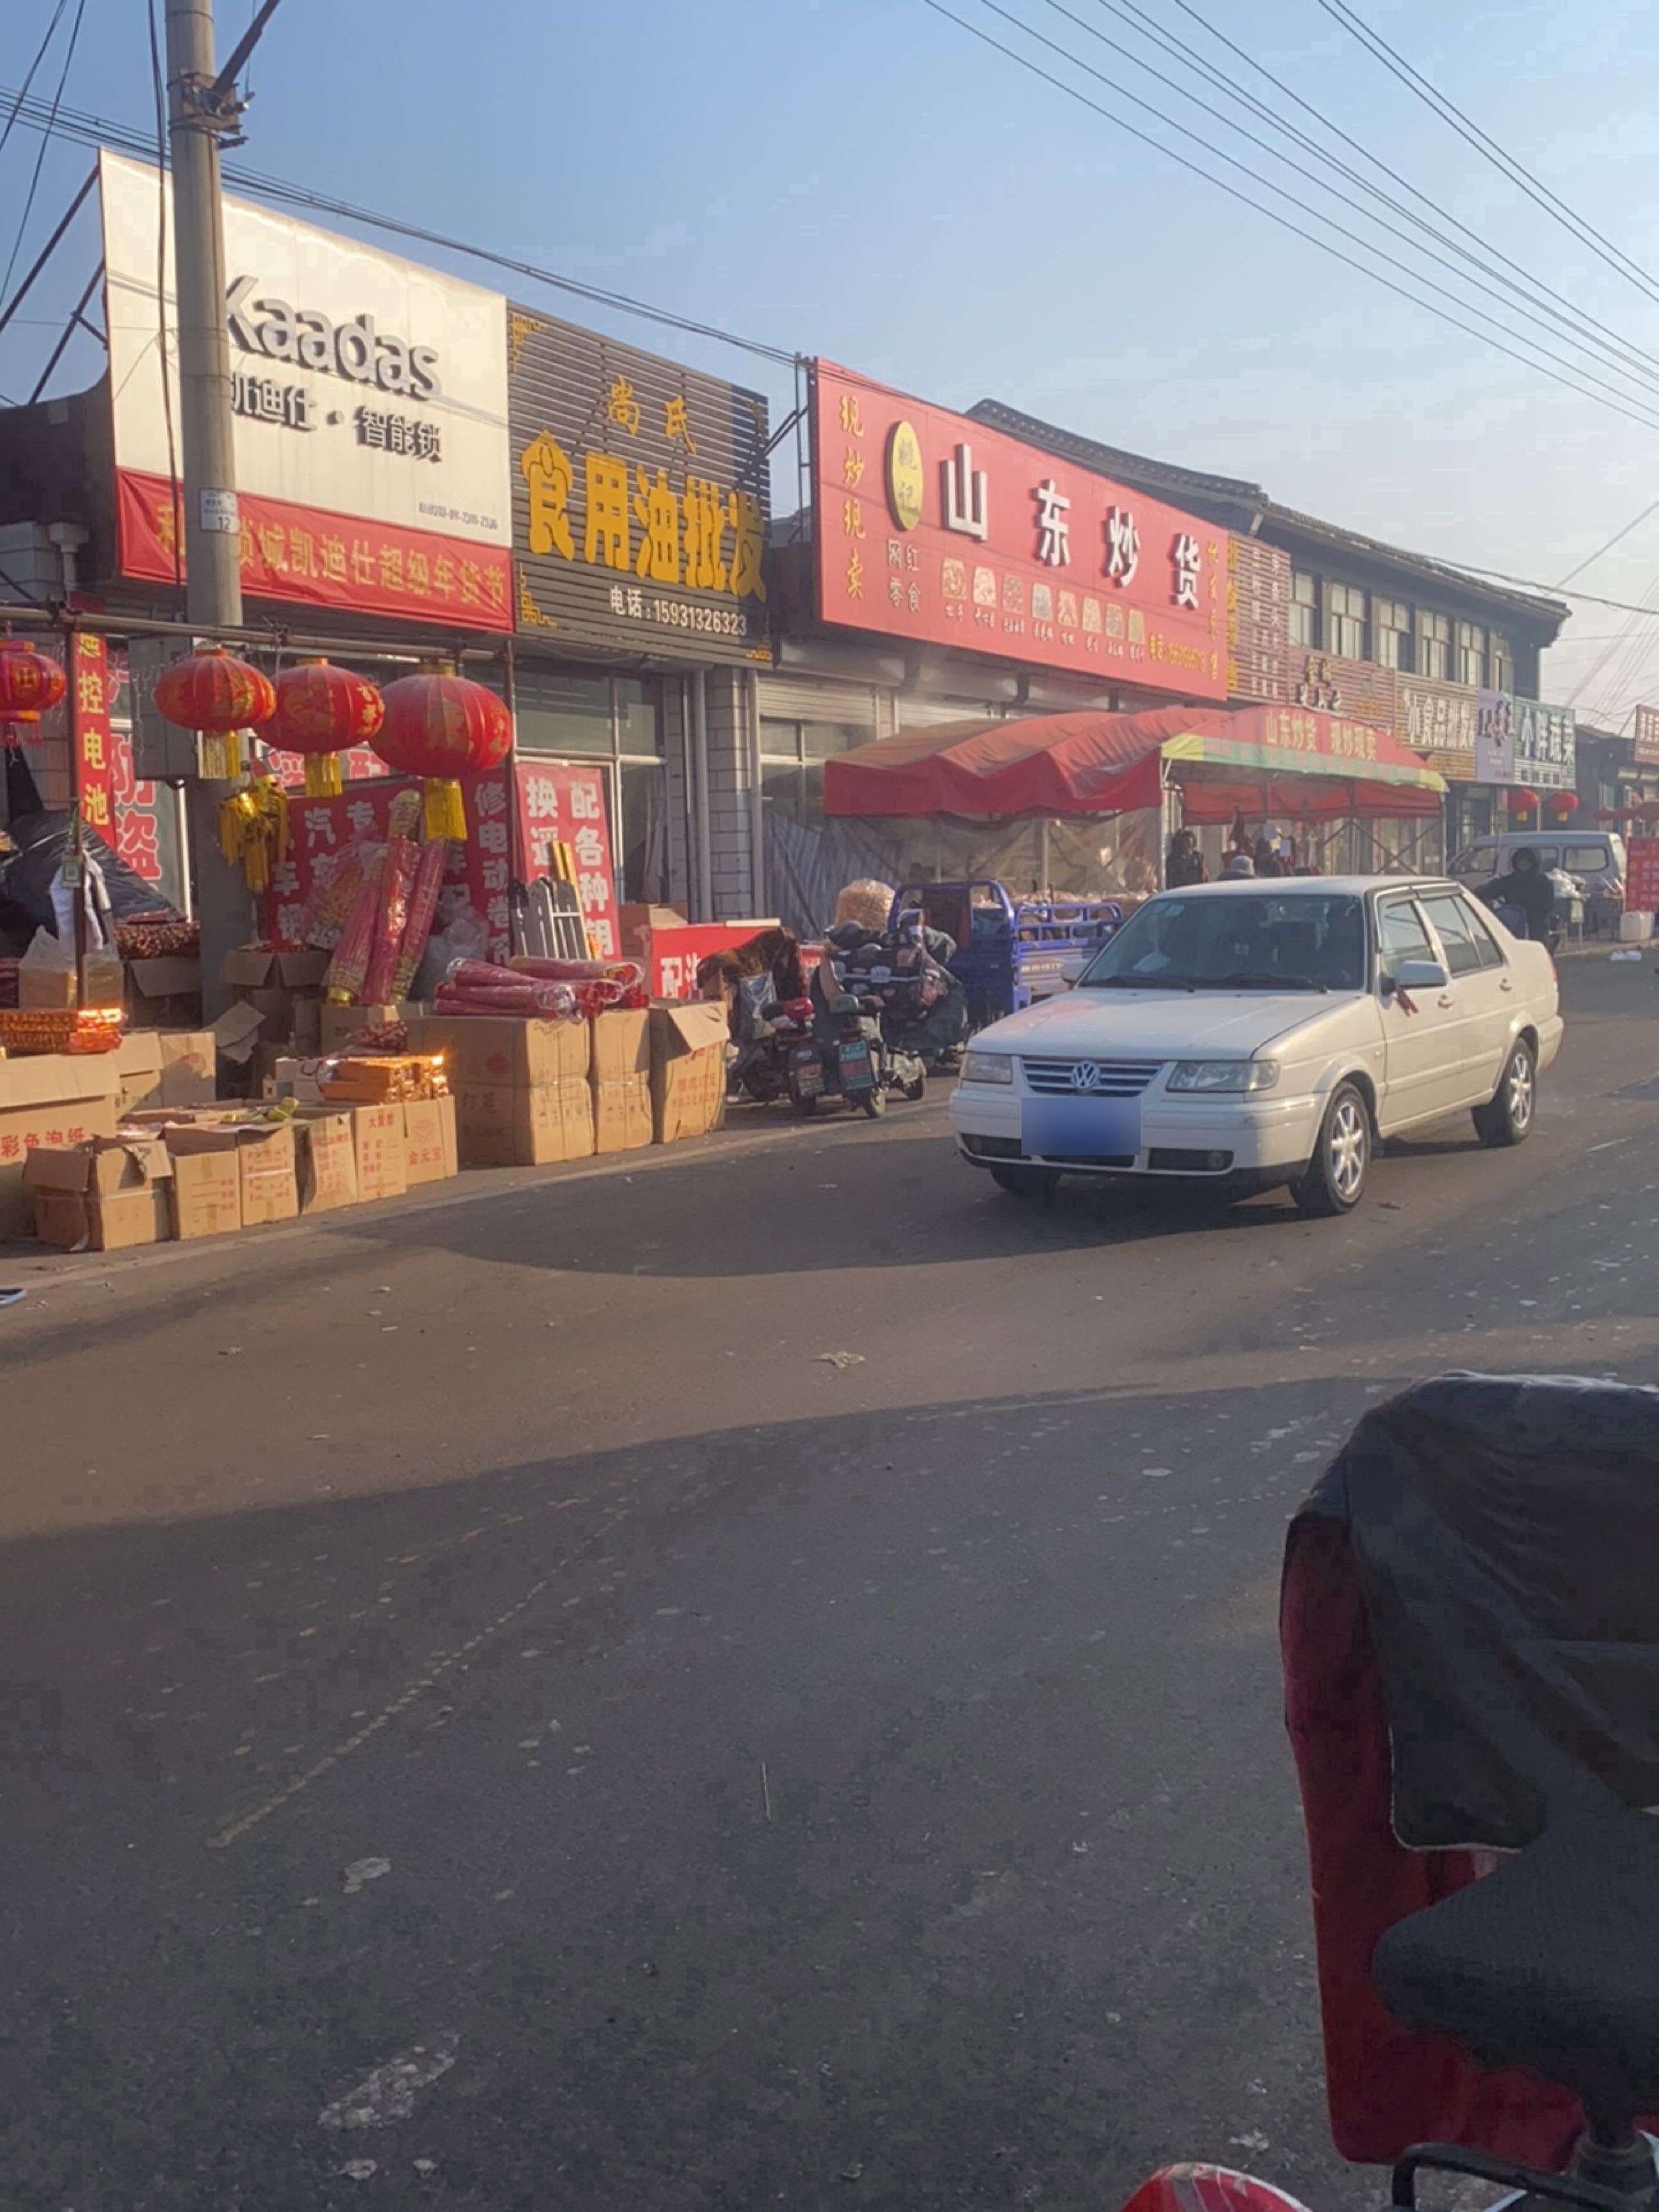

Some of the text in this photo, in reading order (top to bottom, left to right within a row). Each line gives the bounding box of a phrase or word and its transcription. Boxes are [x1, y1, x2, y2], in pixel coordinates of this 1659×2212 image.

[225, 275, 442, 402] Kaadas
[520, 429, 767, 604] 食用油批发
[839, 394, 867, 600] 现炒现卖
[940, 442, 1201, 609] 山东炒货
[609, 584, 748, 637] 电话:15931326323
